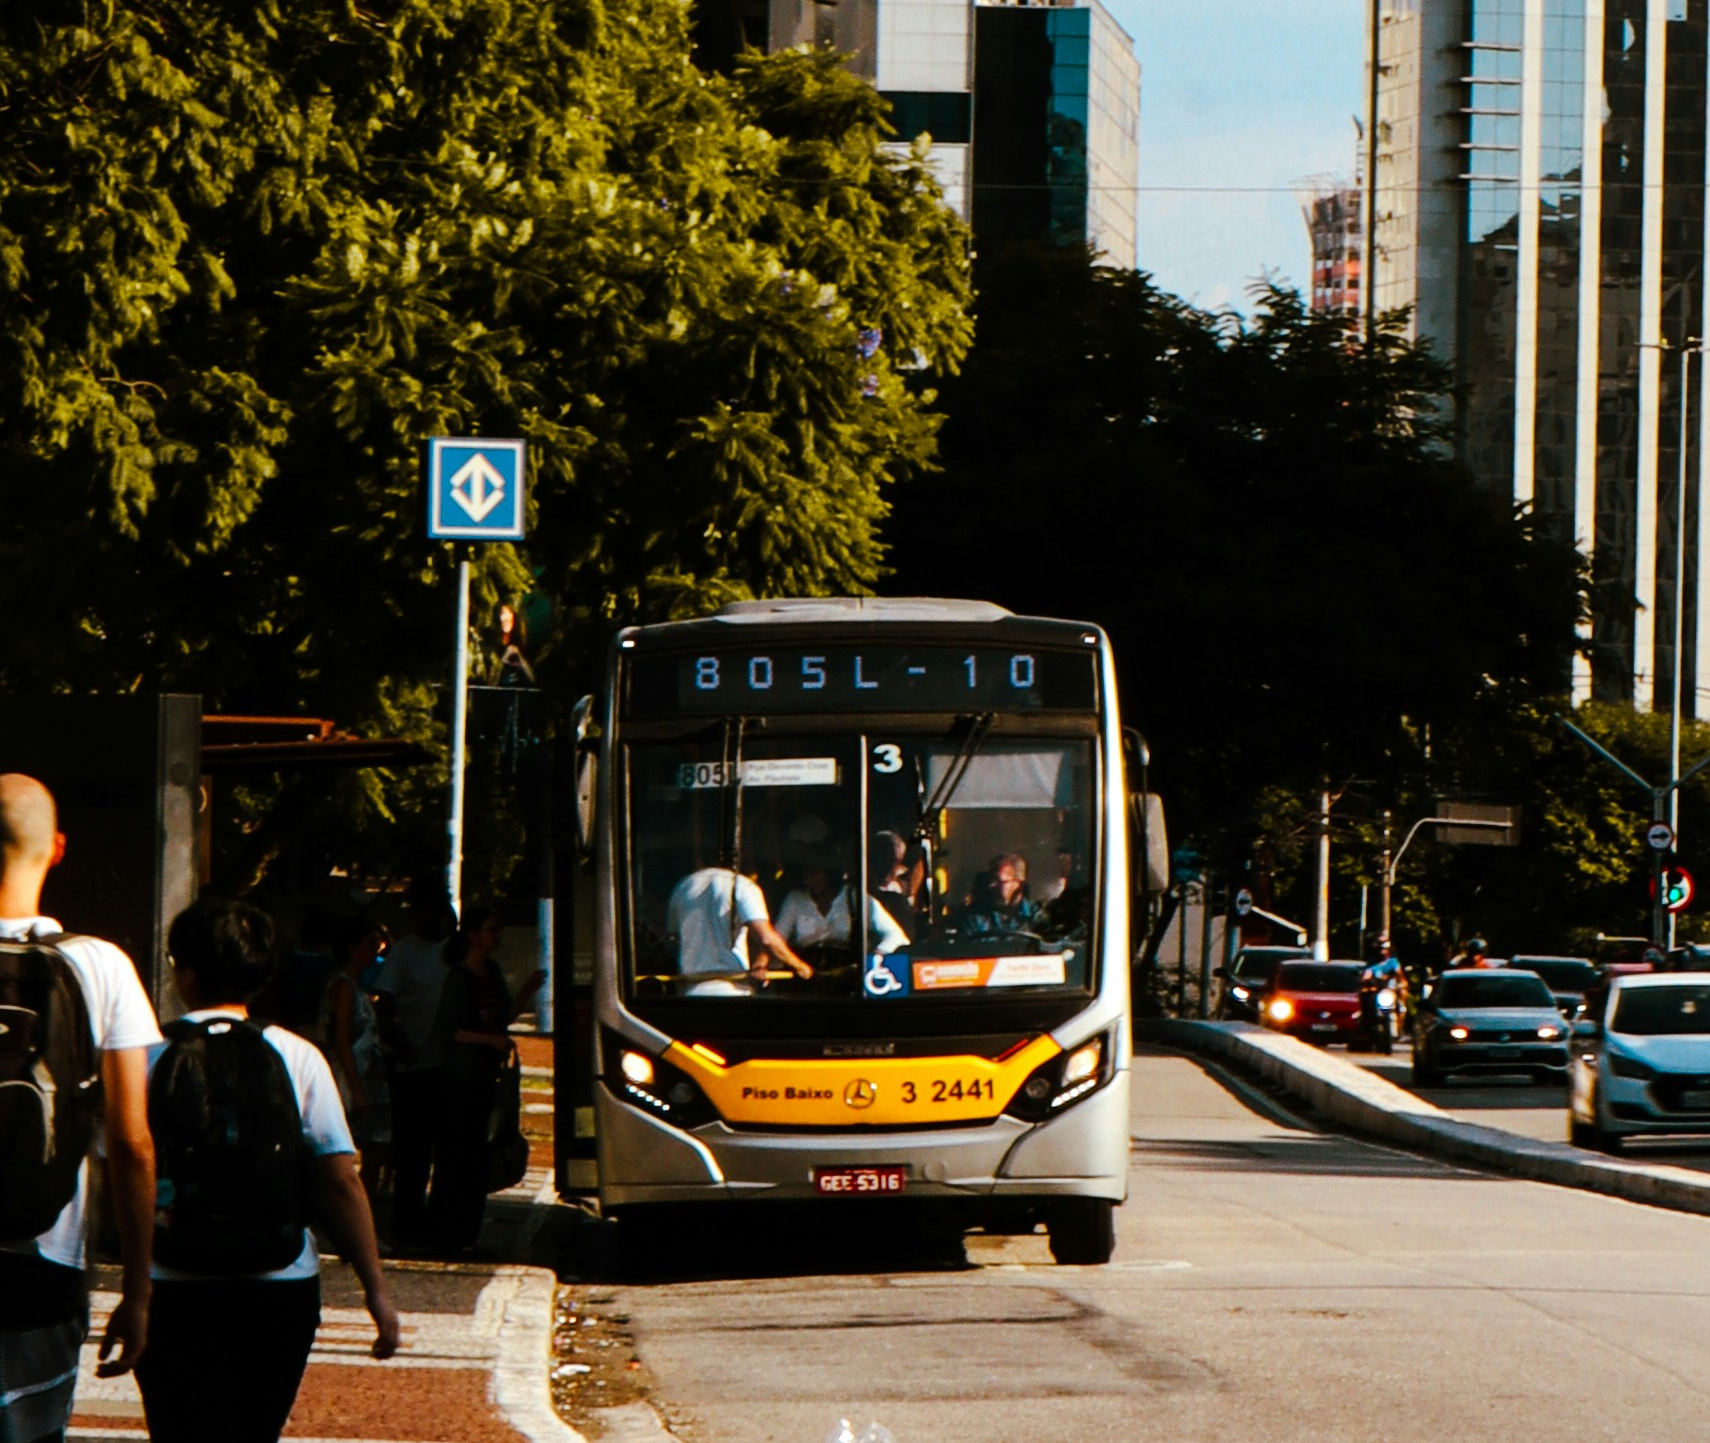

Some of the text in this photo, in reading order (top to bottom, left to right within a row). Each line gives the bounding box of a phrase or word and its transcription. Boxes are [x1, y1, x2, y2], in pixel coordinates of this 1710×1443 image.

[873, 743, 904, 774] 3
[742, 1086, 834, 1100] Piso Baixo
[901, 1078, 995, 1104] 3 2441
